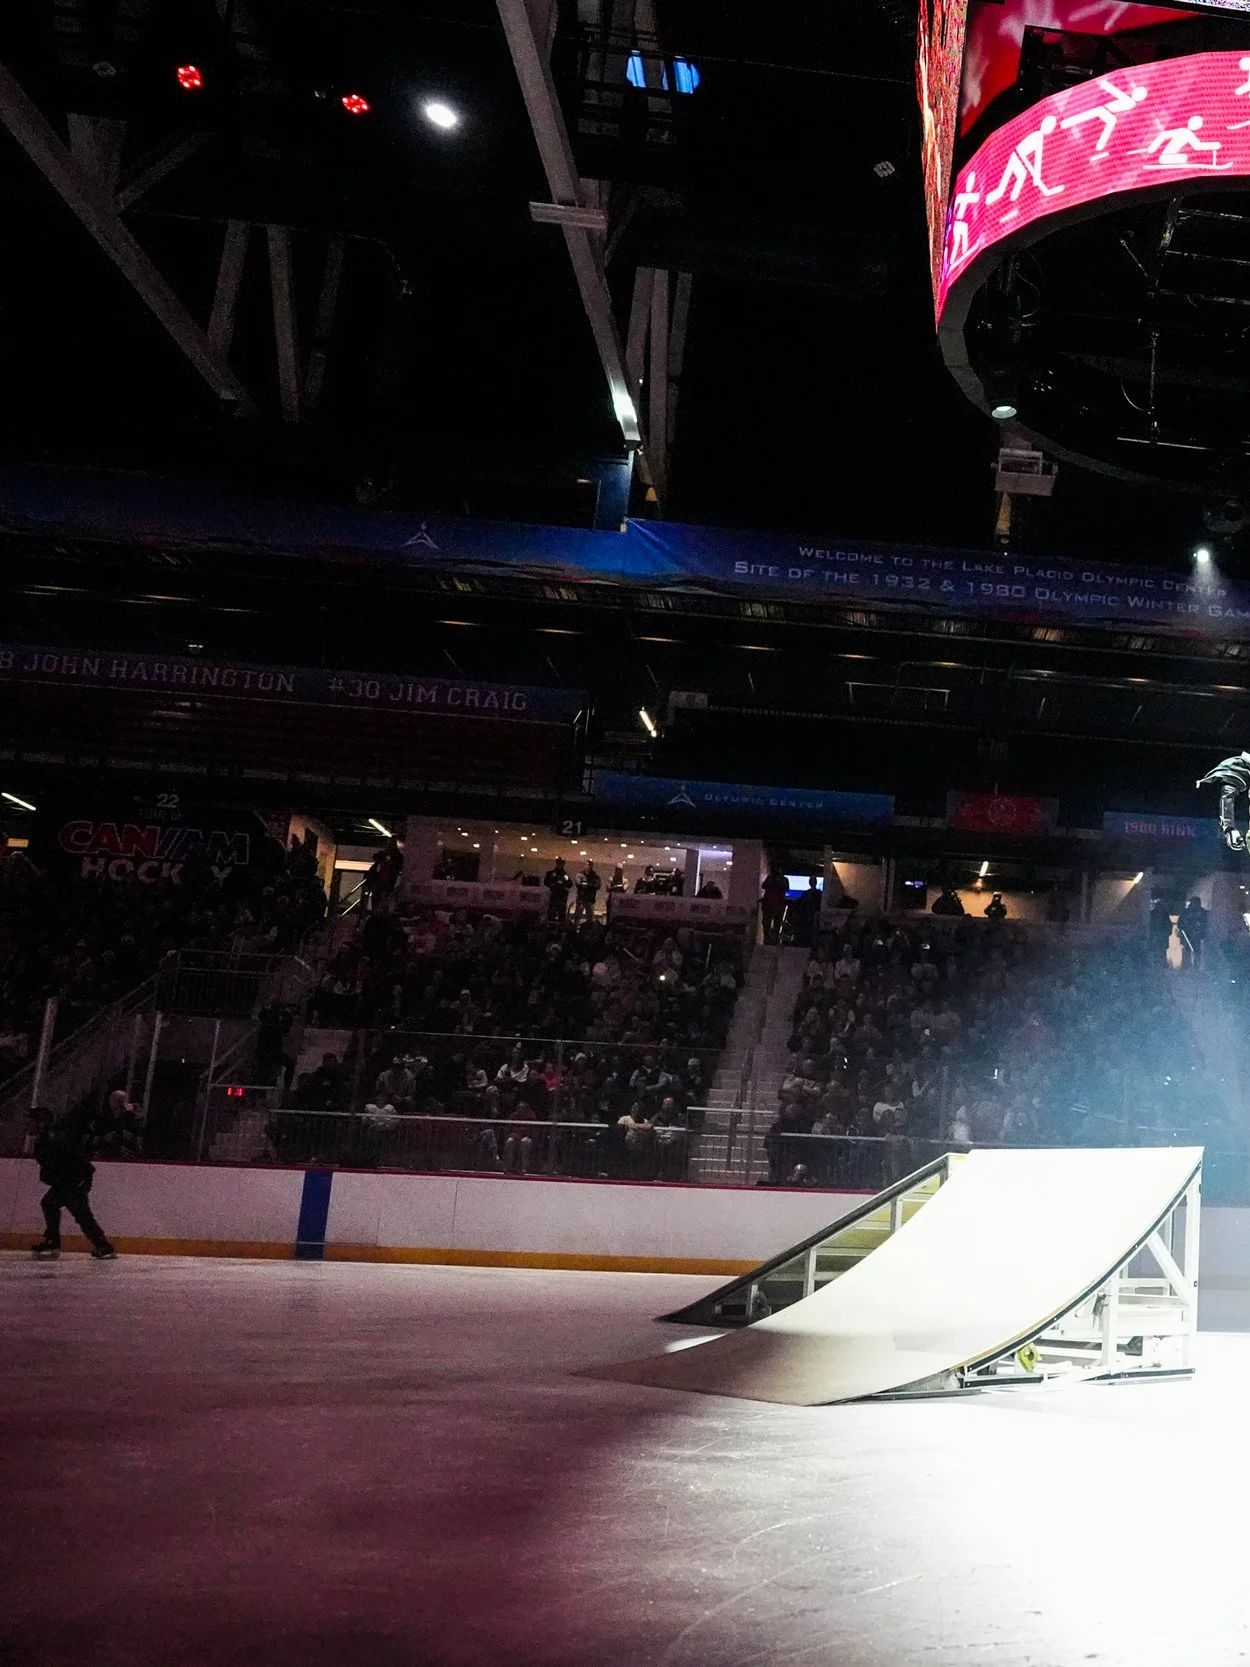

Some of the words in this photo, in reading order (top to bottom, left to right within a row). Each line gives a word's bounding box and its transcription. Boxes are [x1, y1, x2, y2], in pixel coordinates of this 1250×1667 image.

[799, 546, 884, 565] WELCOME
[891, 556, 914, 567] TO
[922, 559, 952, 570] THE
[962, 561, 1004, 575] LAKE
[1013, 565, 1074, 581] PLACID
[1082, 571, 1155, 588] OLYMPIC
[734, 560, 779, 577] SITE
[788, 567, 815, 579] OF
[823, 570, 860, 584] THE
[872, 573, 931, 590] 1932
[940, 579, 955, 593] &
[968, 581, 1026, 599] 1980
[1035, 586, 1121, 607] OLYMPIC
[1127, 594, 1200, 613] WINTER
[24, 651, 101, 676] JOHN
[110, 658, 295, 692] HARRINGTON
[329, 676, 381, 699] #30
[389, 682, 438, 704] JIM
[447, 687, 528, 711] CRAIG
[156, 792, 180, 808] 22
[562, 820, 583, 835] 21
[80, 856, 234, 886] HOCKY
